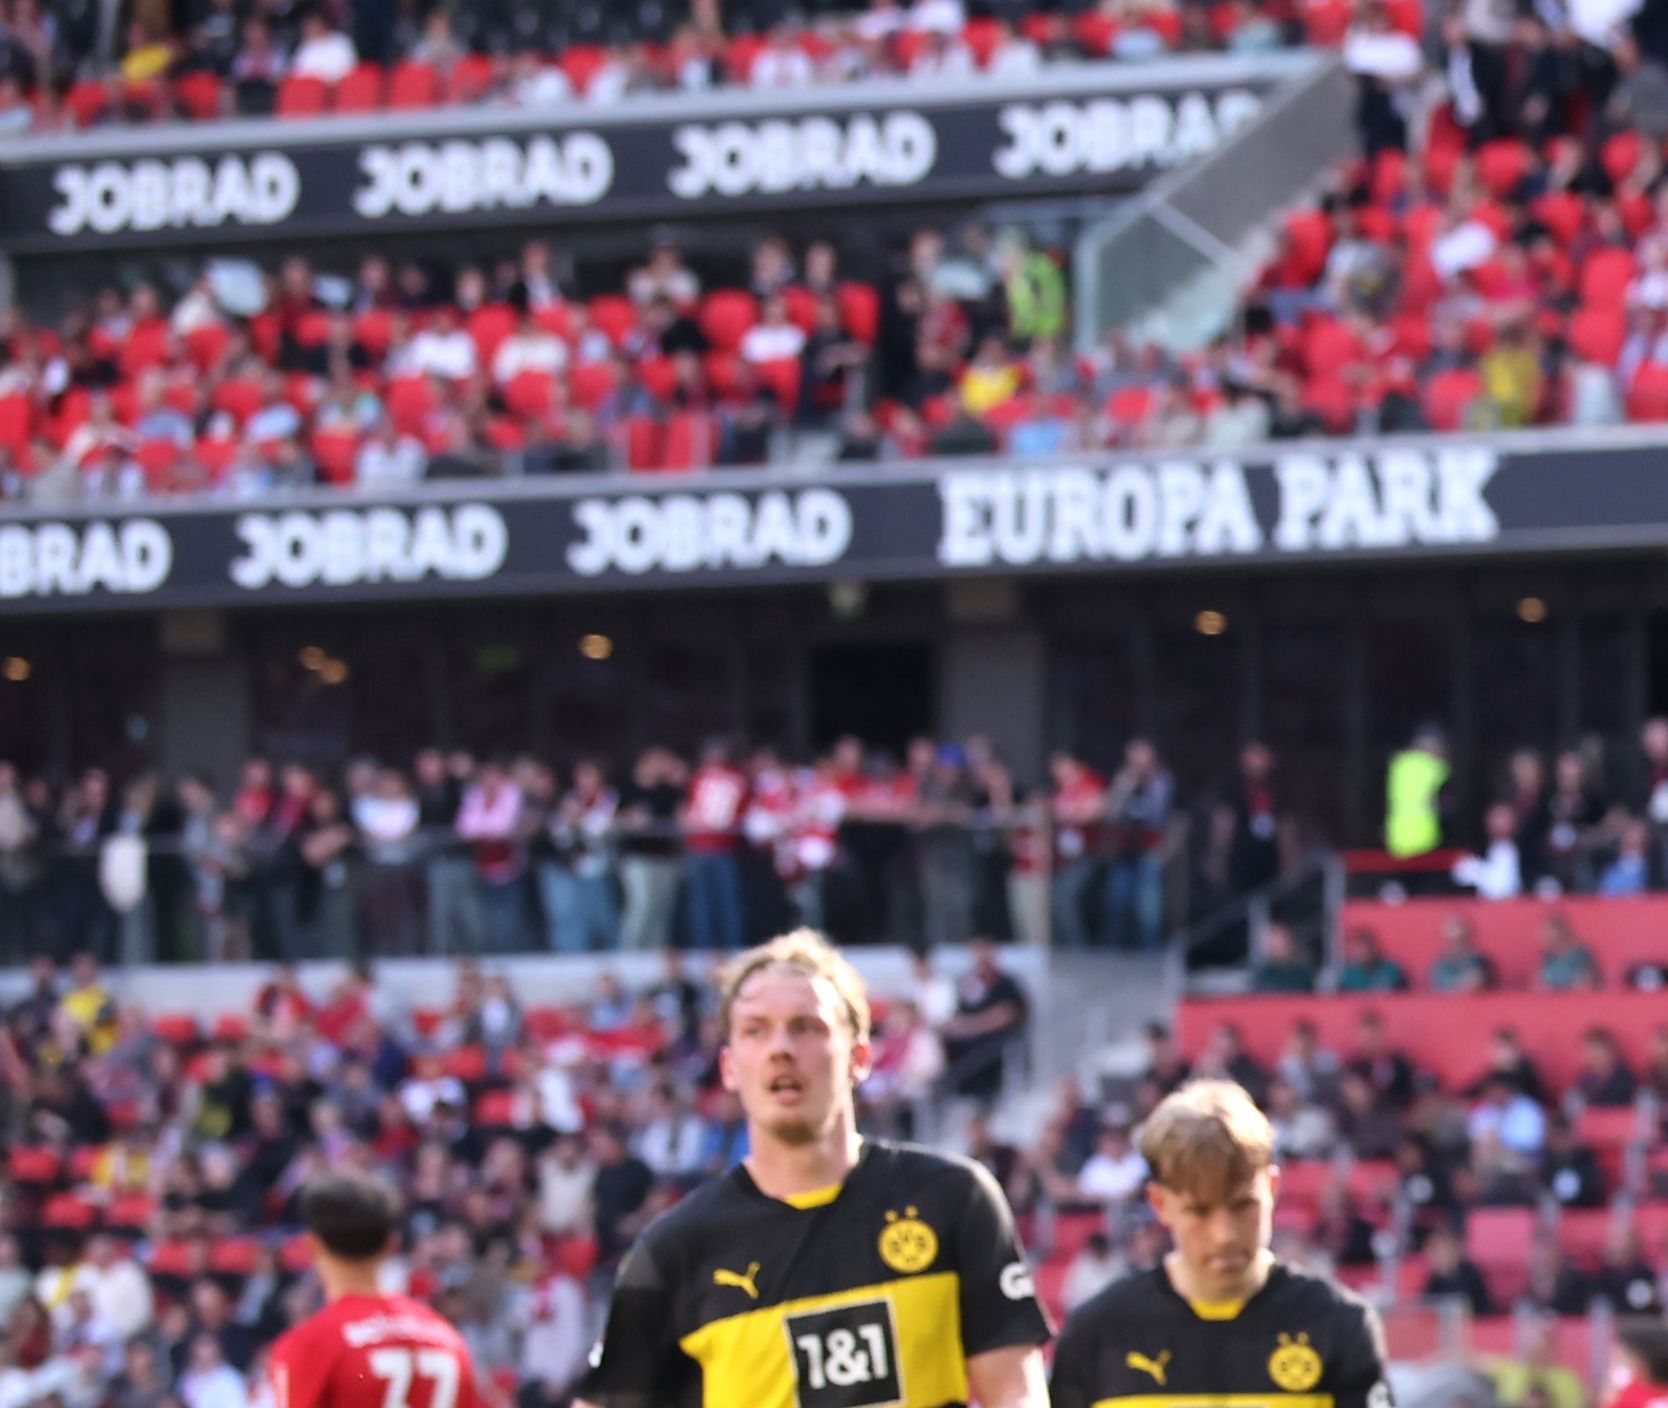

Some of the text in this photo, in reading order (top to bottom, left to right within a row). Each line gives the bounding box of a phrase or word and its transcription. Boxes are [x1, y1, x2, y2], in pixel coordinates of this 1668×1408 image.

[48, 150, 300, 237] JOBRAD
[352, 130, 615, 218] JOBRAD
[666, 110, 938, 198] JOBRAD
[229, 502, 510, 589] JOBRAD
[566, 488, 856, 576] JOBRAD
[937, 446, 1502, 566] EUROPA PARK
[796, 1322, 889, 1389] 1&1
